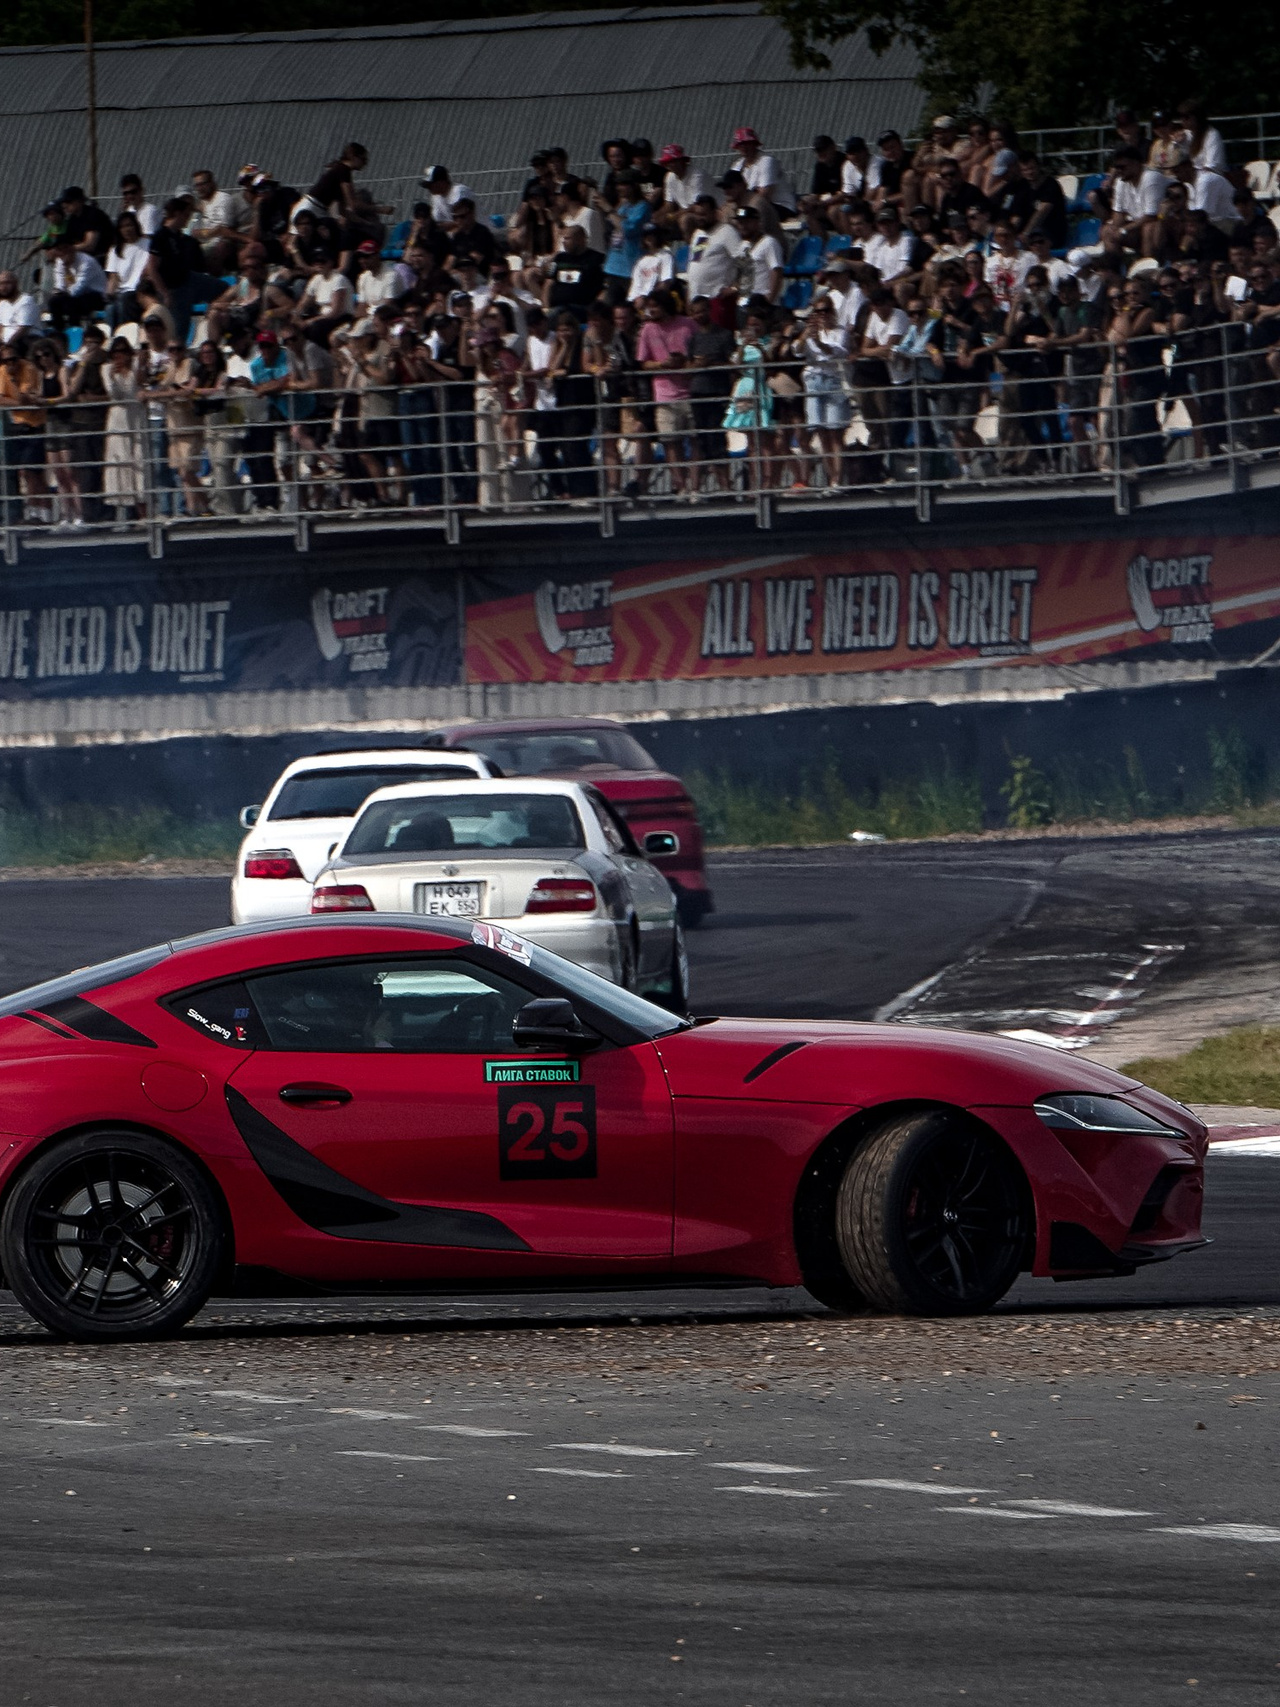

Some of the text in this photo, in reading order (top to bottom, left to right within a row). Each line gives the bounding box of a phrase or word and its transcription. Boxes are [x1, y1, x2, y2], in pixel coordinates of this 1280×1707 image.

[1152, 555, 1212, 589] DRIFT
[333, 587, 389, 619] DRIFT
[557, 580, 613, 613] DRIFT
[701, 568, 1038, 656] ALL WE NEED IS DRIFT
[36, 606, 107, 678] NEED
[114, 604, 143, 674] IS
[149, 600, 230, 672] DRIFT
[494, 1069, 571, 1082] ЛИГА СТАВОК
[506, 1101, 589, 1161] 25
